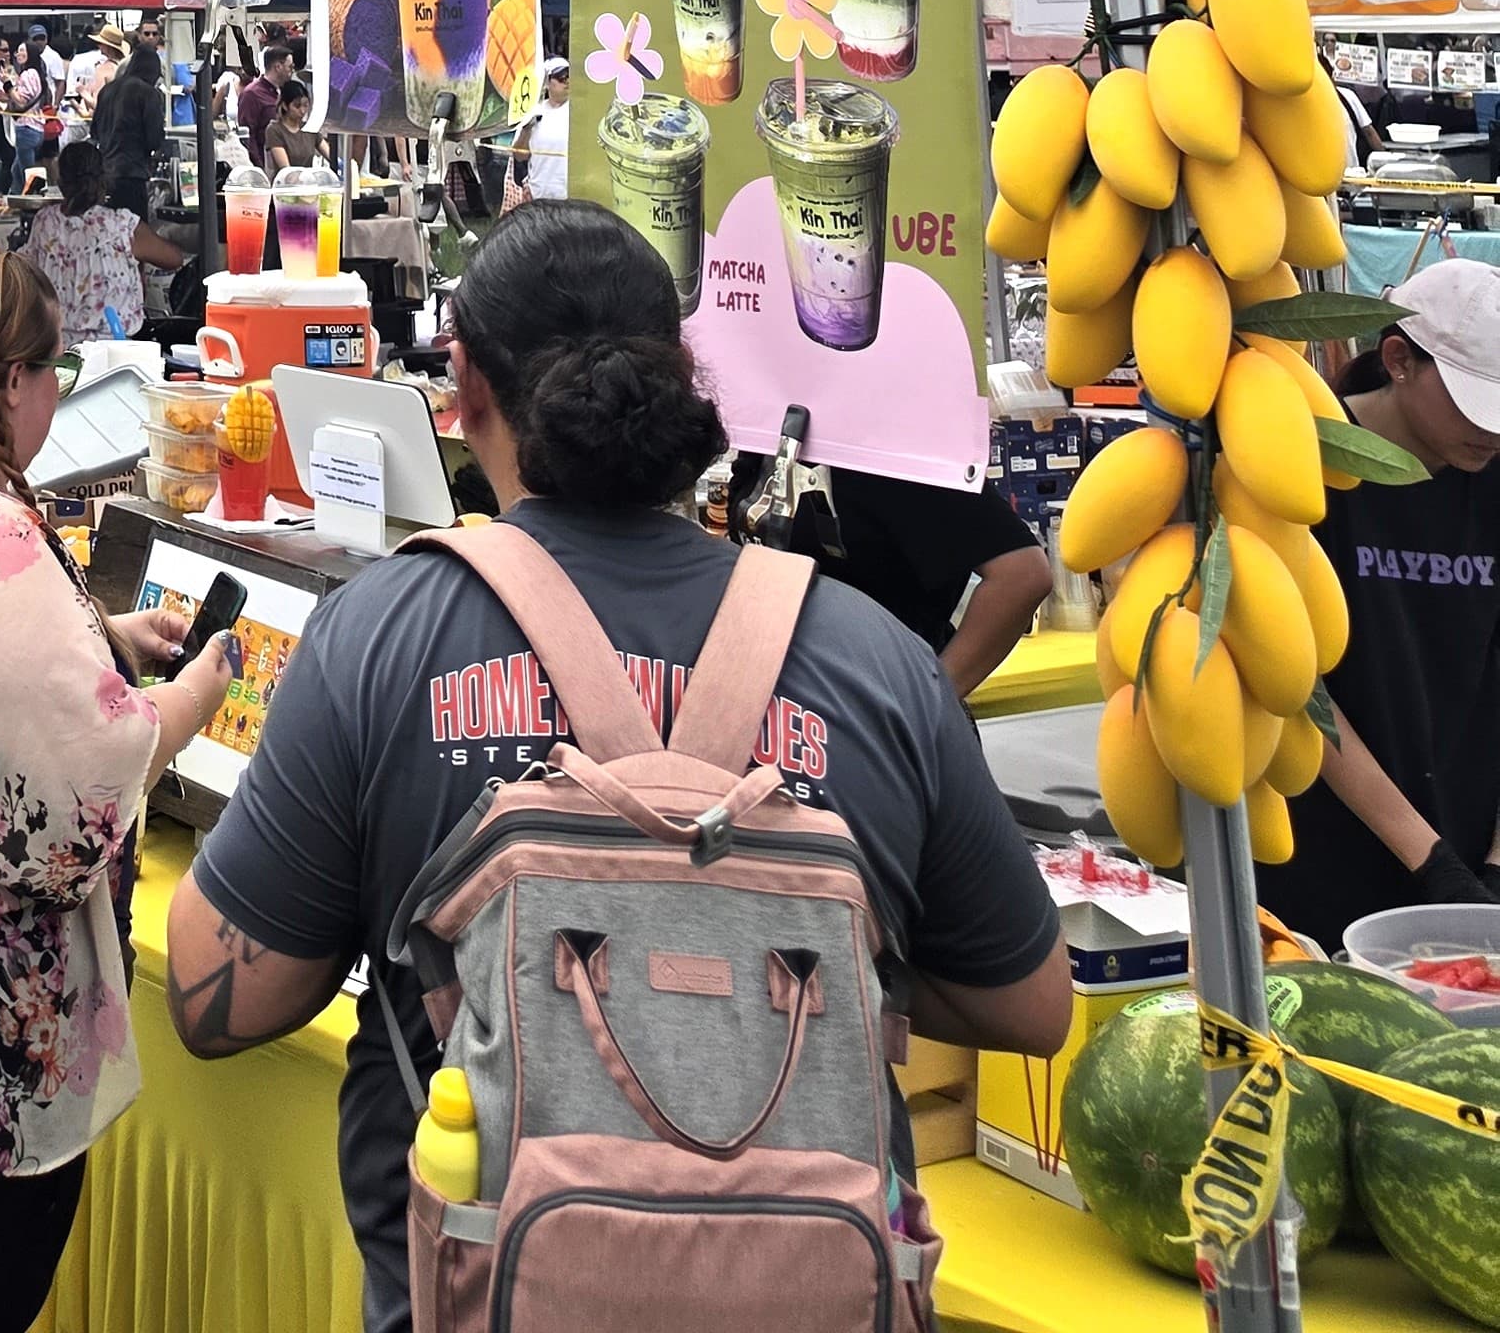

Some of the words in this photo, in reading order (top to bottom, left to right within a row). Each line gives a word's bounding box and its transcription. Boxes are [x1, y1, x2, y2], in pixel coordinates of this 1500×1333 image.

[414, 2, 433, 21] Kin
[435, 0, 464, 20] Thai
[652, 205, 673, 223] Kin
[800, 206, 825, 229] Kin
[829, 206, 863, 230] Thai
[893, 212, 957, 256] UBE
[708, 259, 766, 286] MATCHA
[717, 290, 762, 313] LATTE
[325, 325, 354, 334] IGLOO
[1356, 544, 1495, 587] PLAYBOY
